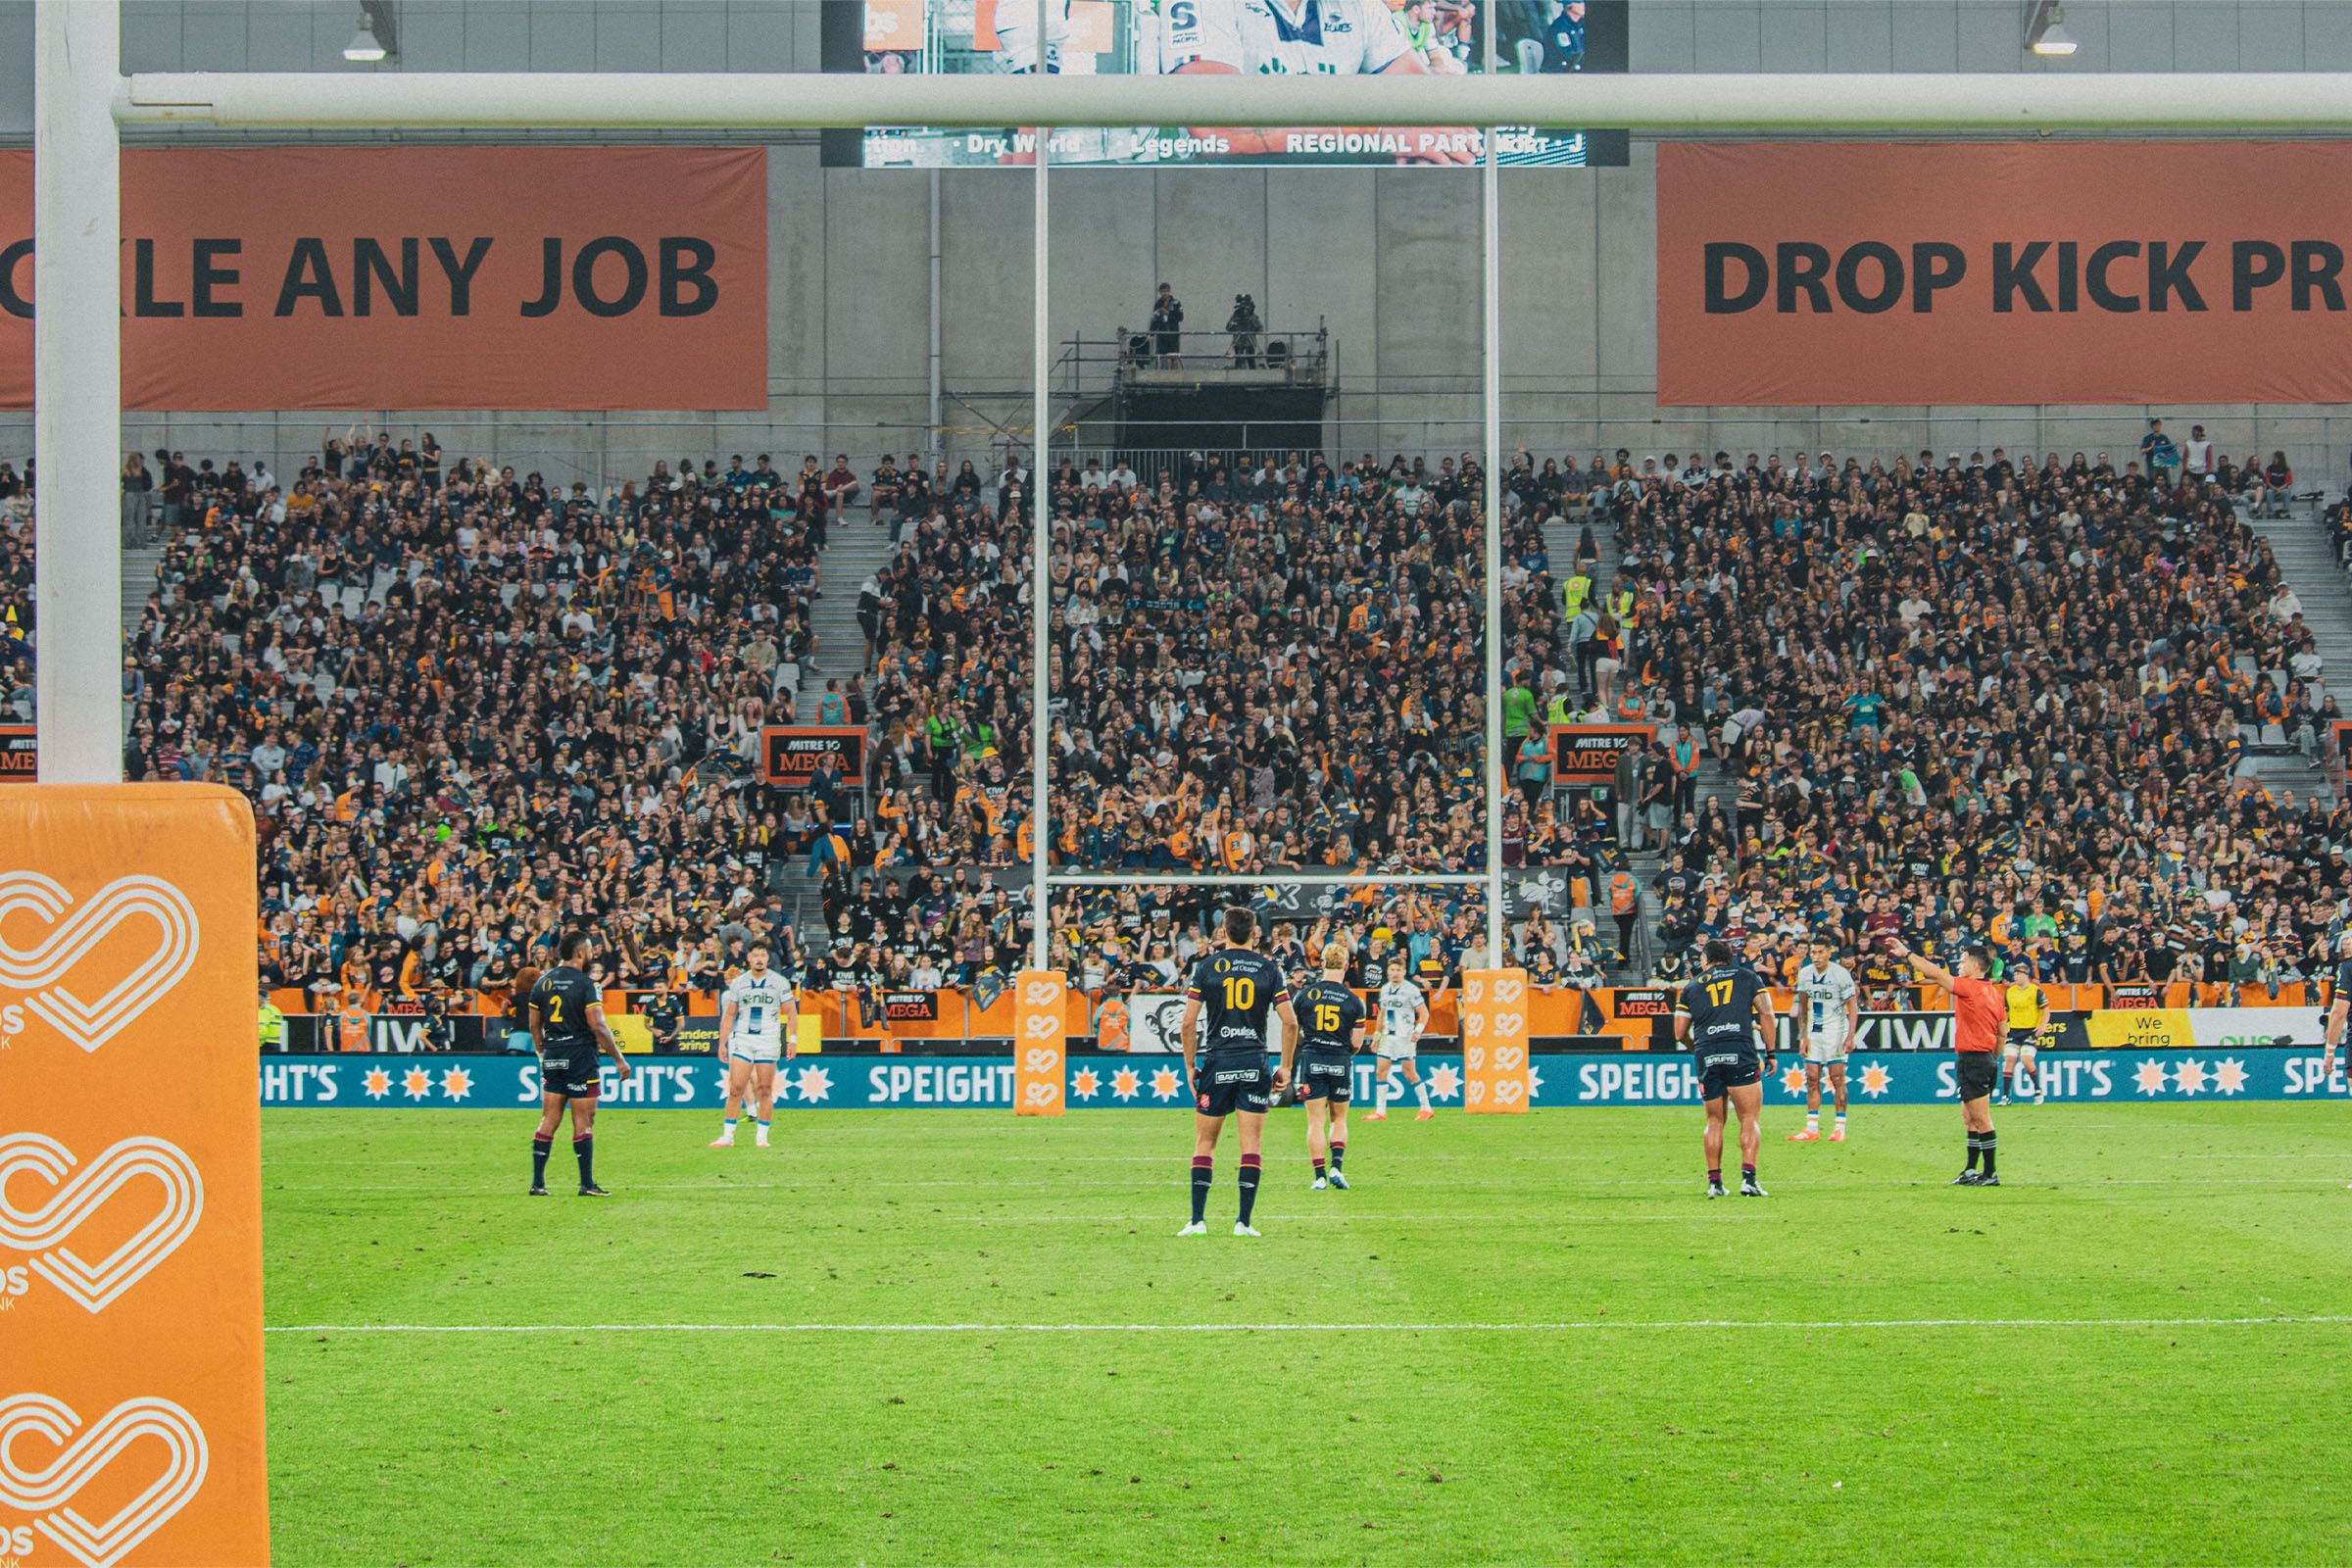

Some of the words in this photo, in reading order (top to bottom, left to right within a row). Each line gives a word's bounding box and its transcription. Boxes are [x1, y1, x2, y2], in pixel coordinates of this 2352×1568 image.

[967, 134, 1007, 158] Dry
[1012, 134, 1079, 153] Wrld
[1132, 134, 1230, 159] Legends
[1286, 133, 1413, 153] REGIONAL
[0, 236, 243, 318] CLE
[273, 237, 494, 318] ANY
[521, 236, 720, 318] JOB
[1703, 241, 1967, 315] DROP
[1992, 240, 2209, 314] KICK
[787, 740, 824, 751] MITRE
[825, 740, 841, 751] 10
[1575, 738, 1611, 749] MITRE
[753, 992, 774, 1004] nib
[887, 995, 913, 1004] MITRE
[1222, 977, 1254, 1010] 10
[1627, 992, 1653, 1001] MITRE
[1653, 992, 1665, 1001] 10
[1706, 979, 1734, 1007] 17
[1813, 989, 1833, 1000] nib
[549, 996, 564, 1022] 2
[1619, 1002, 1671, 1015] MEGA
[2110, 997, 2159, 1009] MEGA
[884, 1004, 932, 1017] MEGA
[1314, 1004, 1341, 1032] 15
[2135, 1017, 2162, 1029] We
[2128, 1032, 2170, 1047] bring
[517, 1065, 696, 1102] SGHT'S
[1935, 1060, 2113, 1098] SGHT'S
